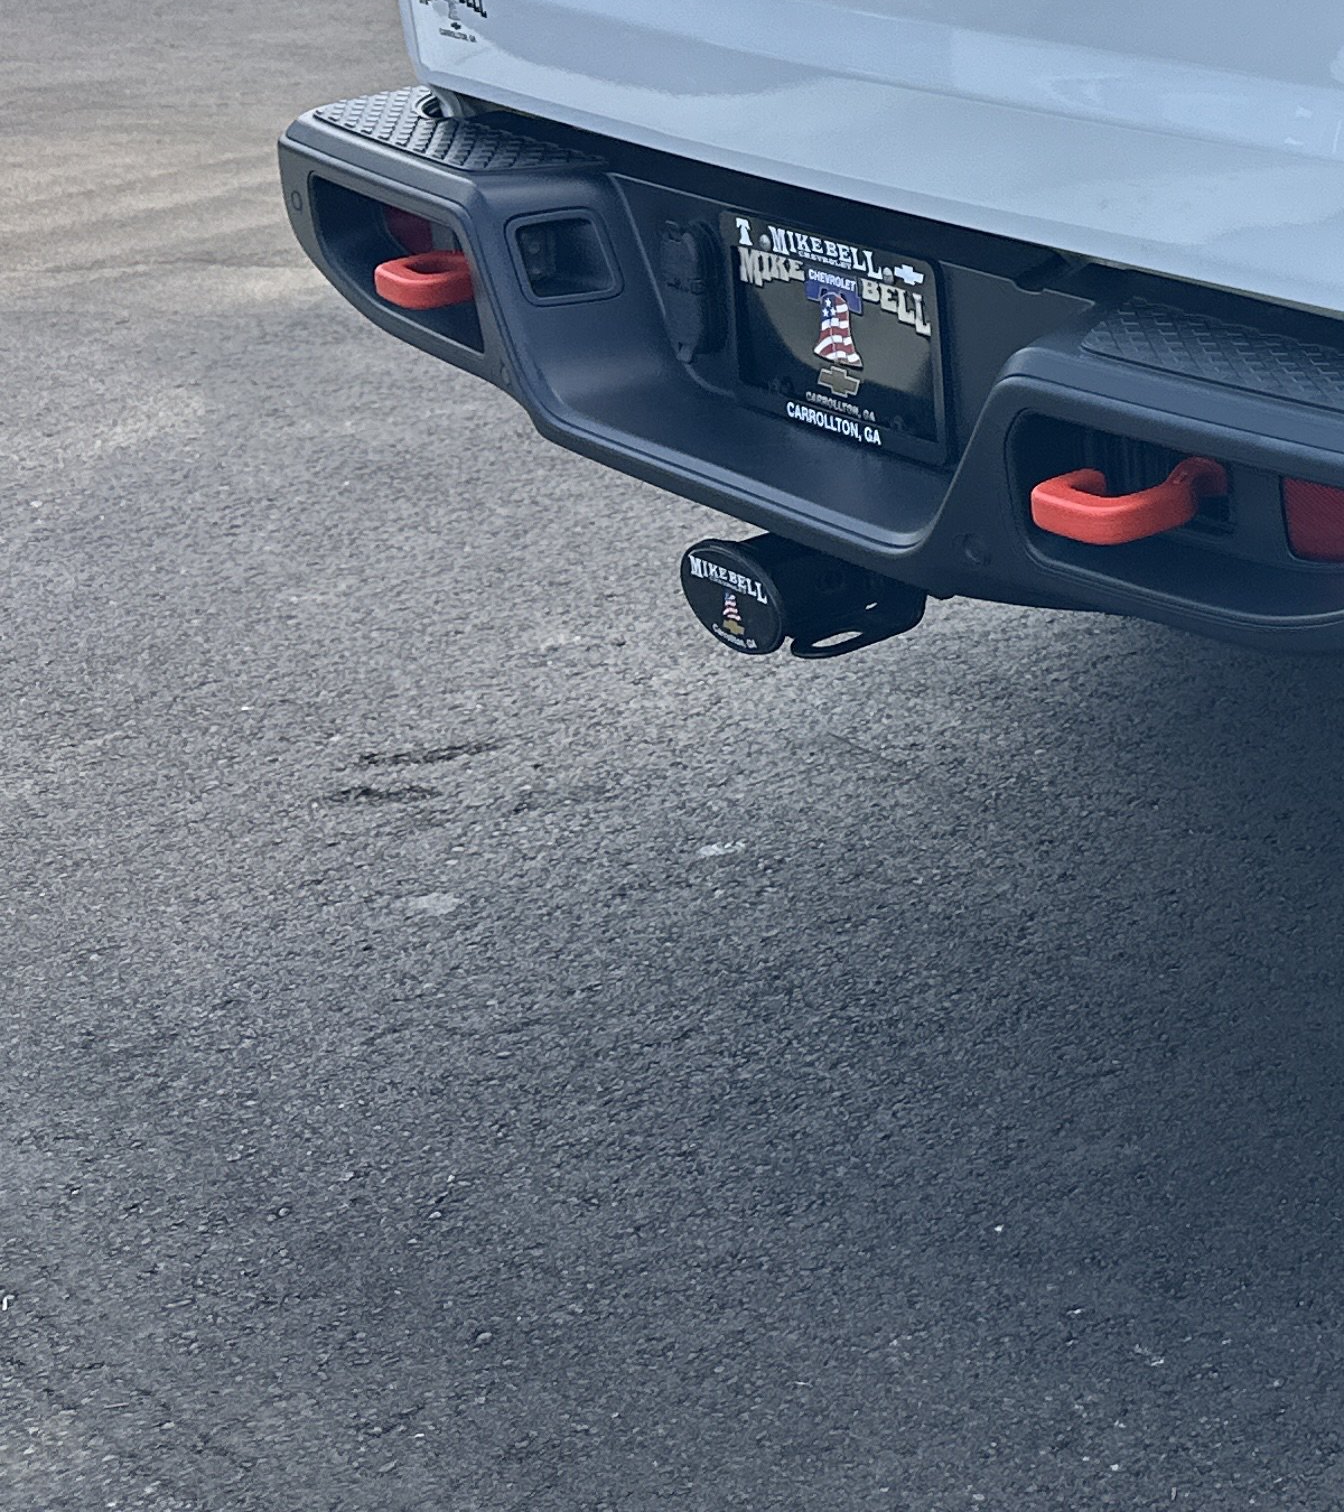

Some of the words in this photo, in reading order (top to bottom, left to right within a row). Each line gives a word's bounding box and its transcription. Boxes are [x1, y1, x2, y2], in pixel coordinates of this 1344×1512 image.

[738, 246, 806, 288] MIKE
[808, 268, 857, 292] CHEVROLET
[861, 278, 932, 337] BELL
[786, 401, 862, 442] CARROLLTON,
[864, 426, 882, 446] GA
